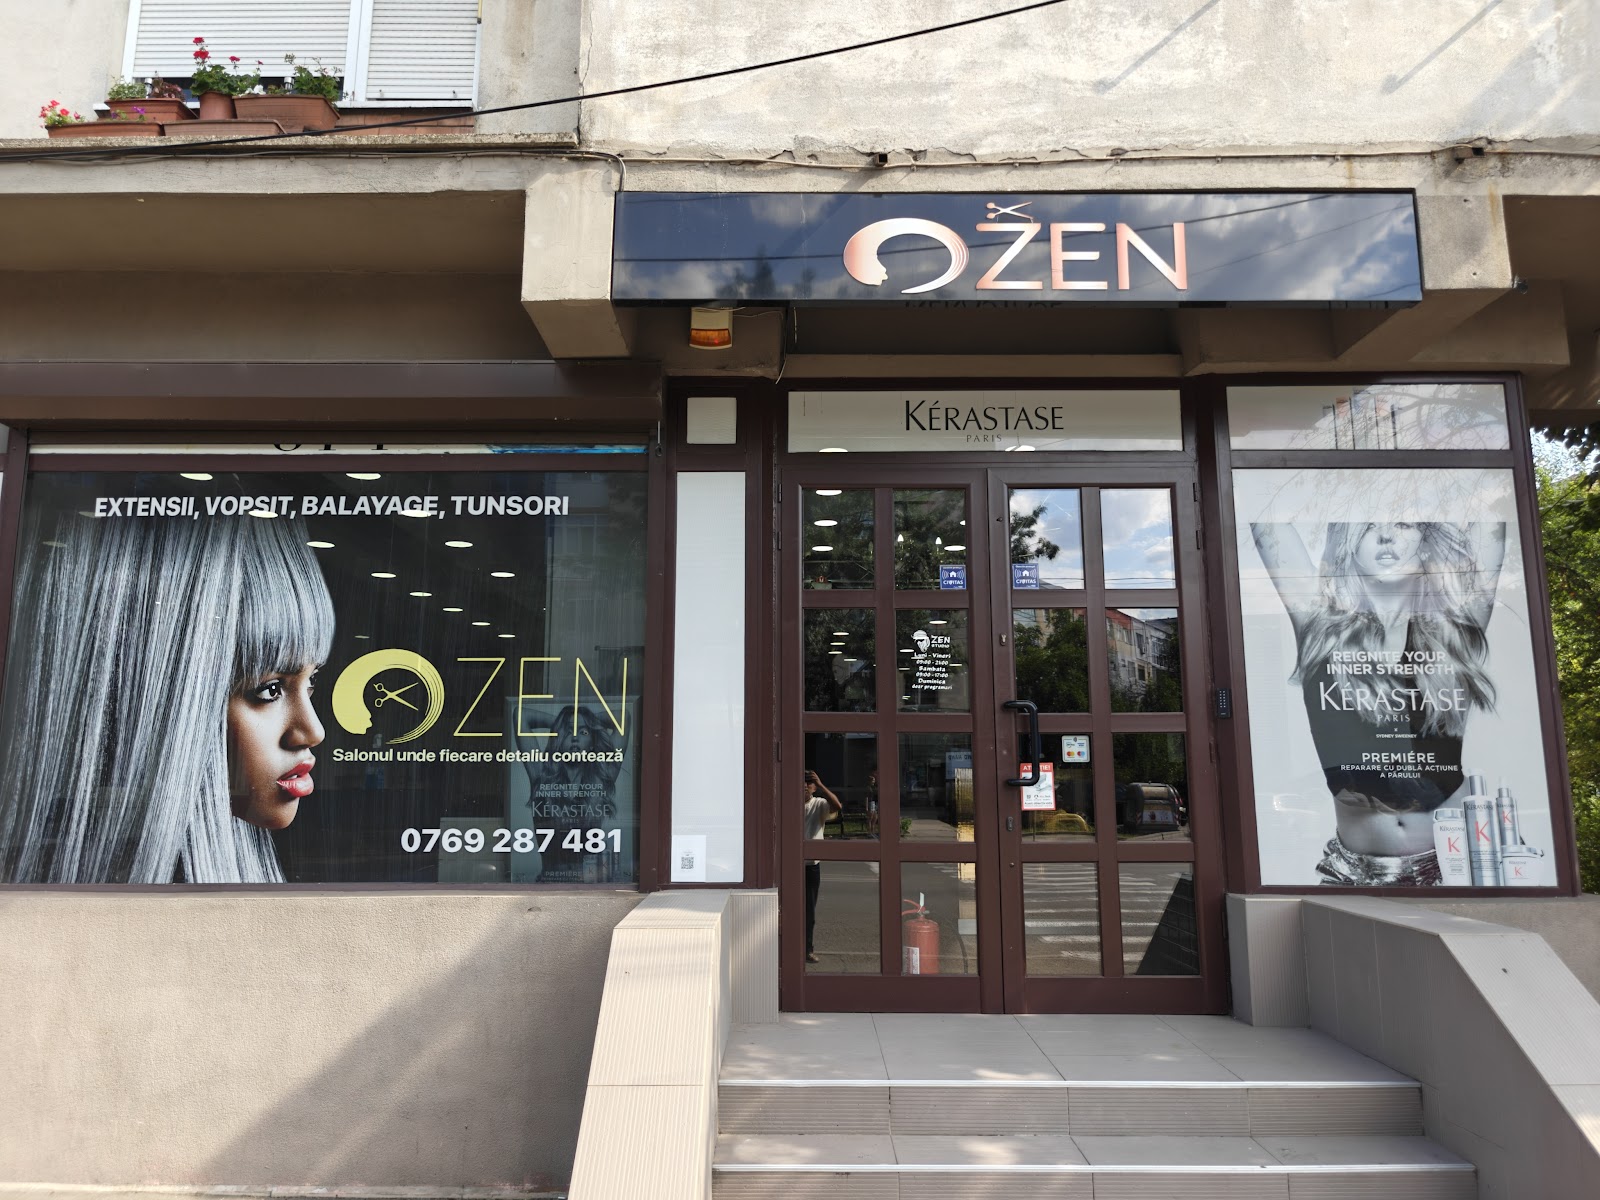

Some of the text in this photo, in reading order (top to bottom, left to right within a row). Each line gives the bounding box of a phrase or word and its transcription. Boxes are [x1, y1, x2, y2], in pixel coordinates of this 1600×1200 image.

[905, 400, 1065, 431] KÉRASTASE
[966, 434, 1002, 443] PARIS
[94, 496, 569, 520] EXTENSII, VOPSIT, BALAYAGE, TUNSORI
[930, 635, 951, 644] ZEN
[1332, 651, 1446, 662] REIGNITE YOUR
[1326, 664, 1454, 675] INNER STRENGTH
[1319, 681, 1467, 712] KÉRASTASE
[1377, 714, 1411, 722] PARIS
[333, 748, 623, 763] Salonul unde fiecare detaliu contează
[1361, 751, 1436, 763] PREMIÉRE
[532, 801, 610, 818] KÉRASTASE
[1475, 821, 1490, 842] K
[400, 828, 621, 853] 0769 287 481
[1447, 837, 1460, 853] K
